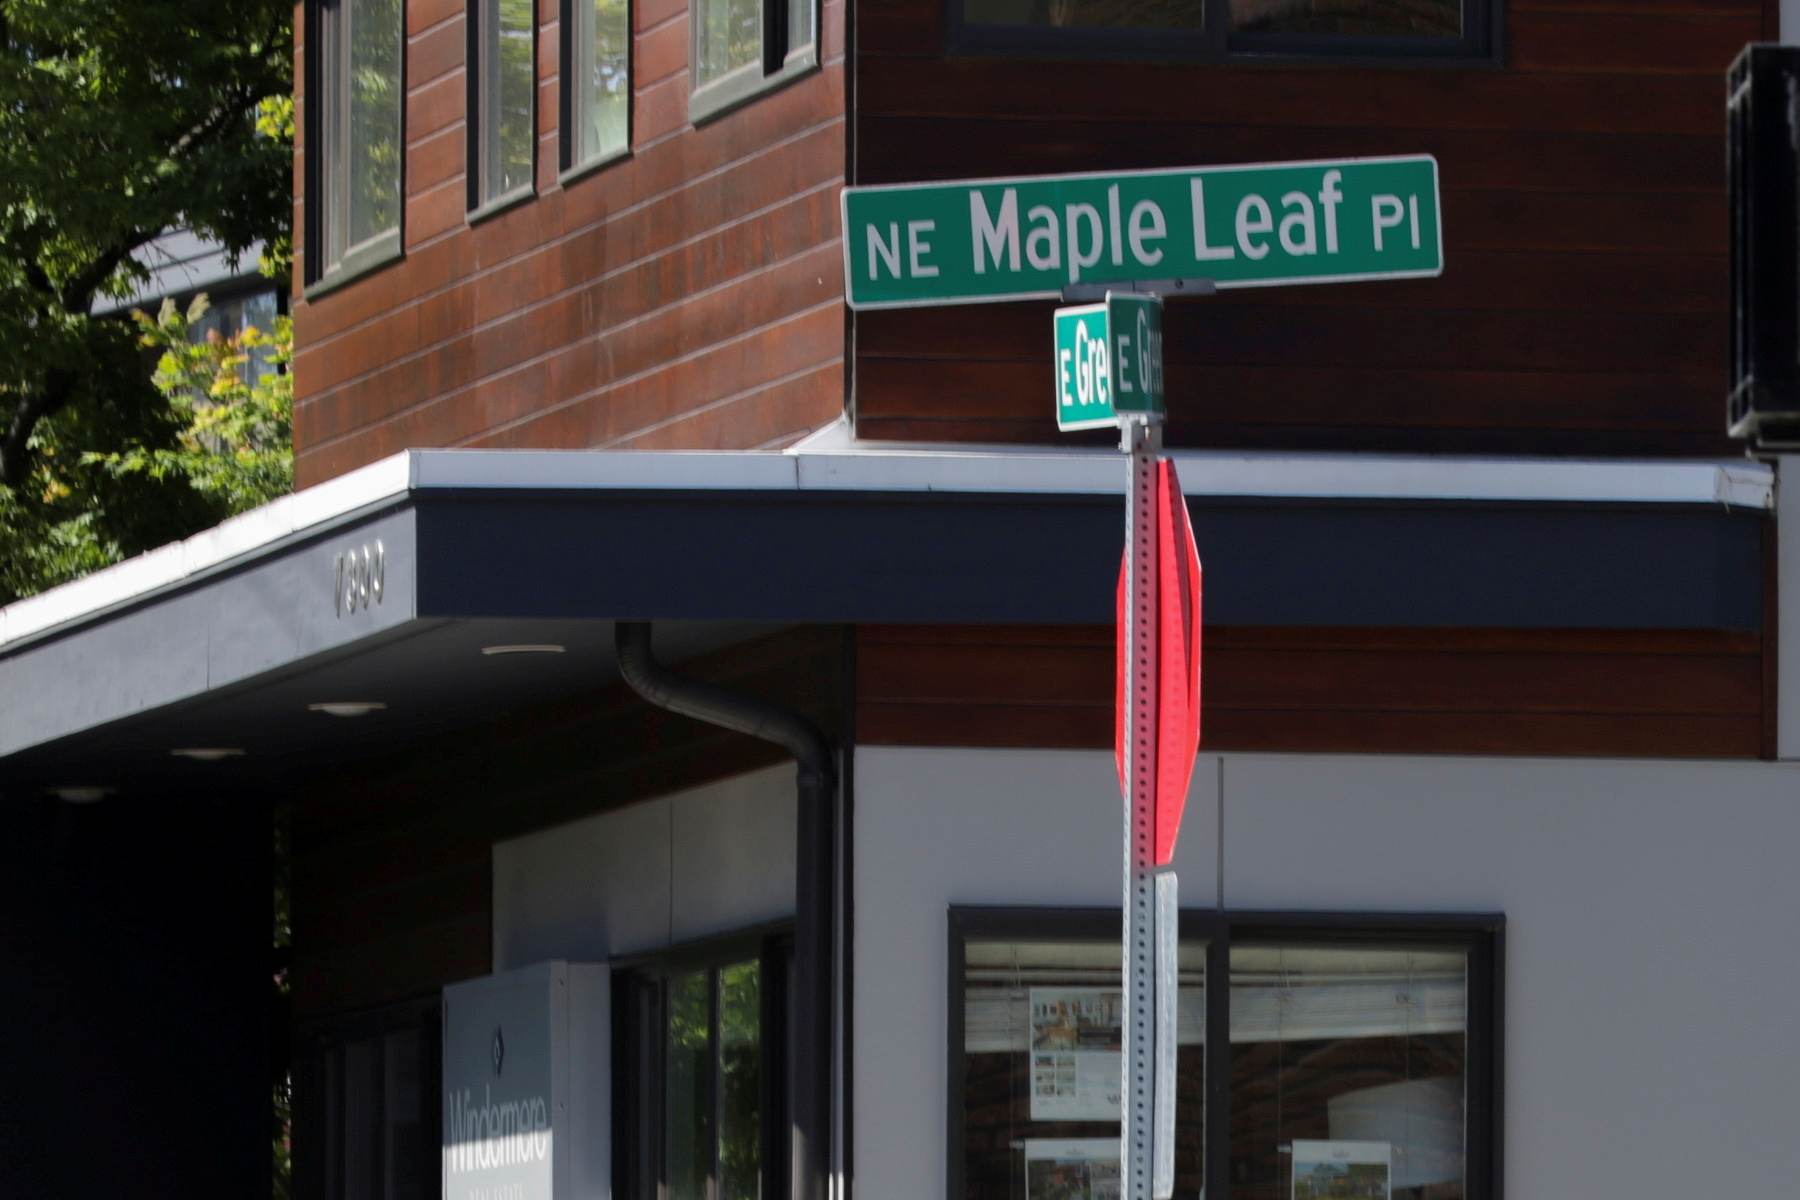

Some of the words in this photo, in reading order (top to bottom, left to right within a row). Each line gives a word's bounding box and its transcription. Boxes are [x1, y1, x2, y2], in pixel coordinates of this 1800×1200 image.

[866, 219, 939, 280] NE
[968, 182, 1167, 284] Maple
[1189, 169, 1343, 261] Leaf
[1371, 193, 1422, 252] Pl
[1060, 348, 1074, 407] E
[1075, 318, 1108, 406] Gre
[1117, 334, 1134, 393] E
[449, 1083, 547, 1174] Windermere
